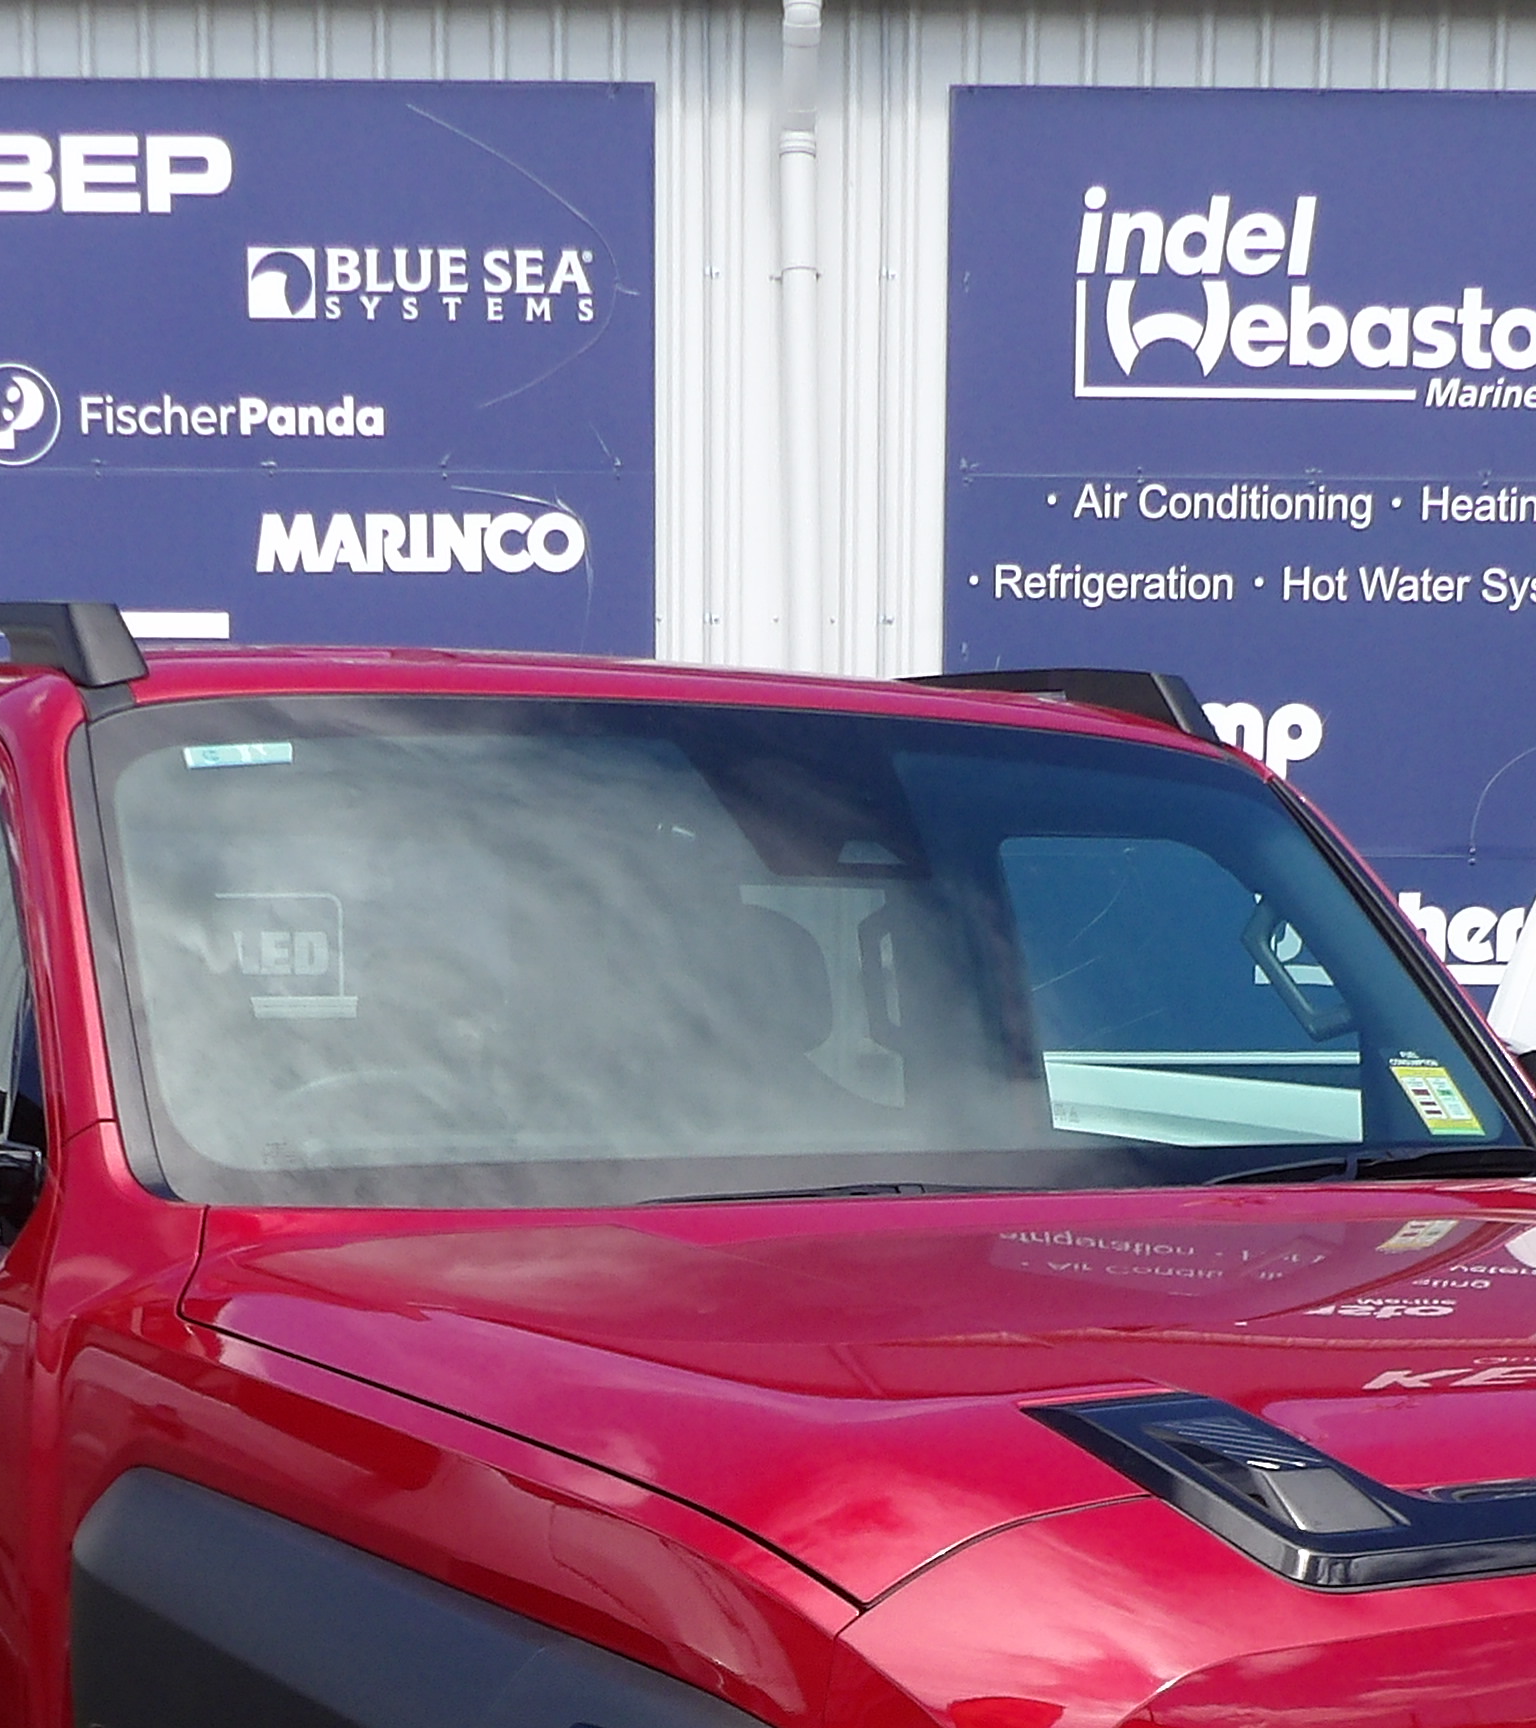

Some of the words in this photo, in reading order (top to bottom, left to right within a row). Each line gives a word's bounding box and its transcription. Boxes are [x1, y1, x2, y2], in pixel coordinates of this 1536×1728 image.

[1076, 186, 1317, 276] indel
[325, 248, 469, 294] BLUE
[483, 249, 594, 296] SEA
[324, 296, 595, 323] SYSTEMS
[80, 395, 386, 437] FischerPanda
[1074, 484, 1127, 519] Air
[1138, 485, 1374, 530] Conditioning
[257, 512, 586, 574] MARINCO
[994, 564, 1234, 608] Refrigeration
[1282, 567, 1347, 602] Hot
[1360, 567, 1470, 604] Water
